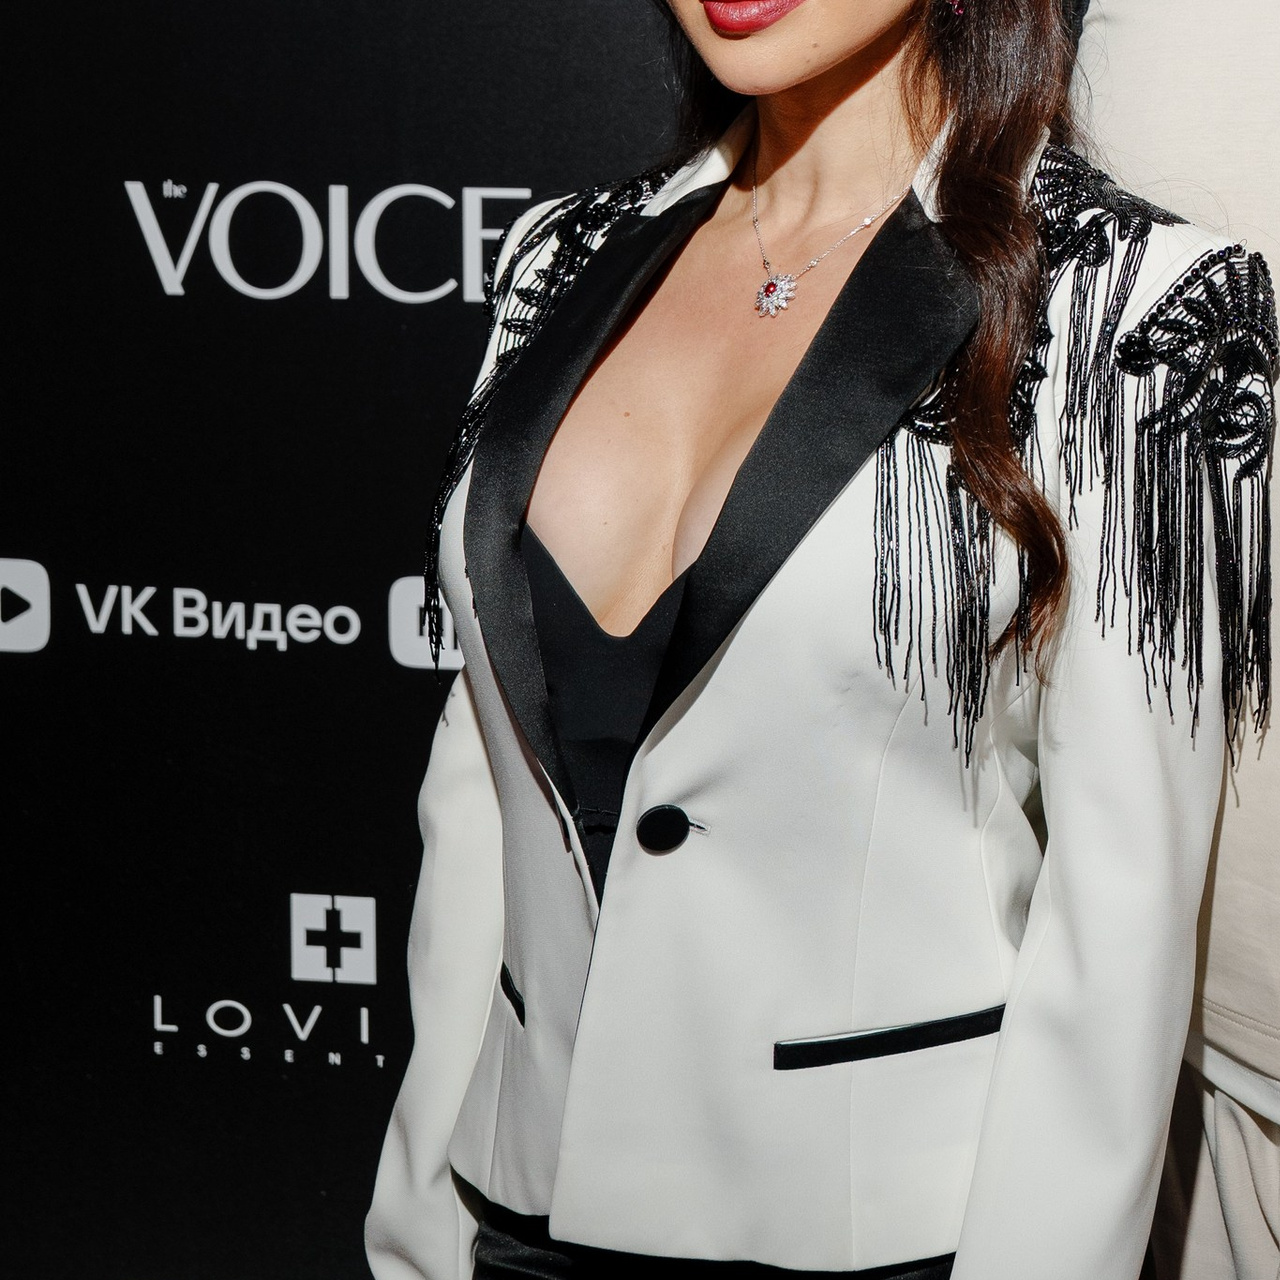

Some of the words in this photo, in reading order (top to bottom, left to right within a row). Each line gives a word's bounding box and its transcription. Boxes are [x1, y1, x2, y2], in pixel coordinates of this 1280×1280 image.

[124, 179, 532, 304] VOICE
[75, 583, 159, 636] VK
[173, 587, 361, 652] Видео
